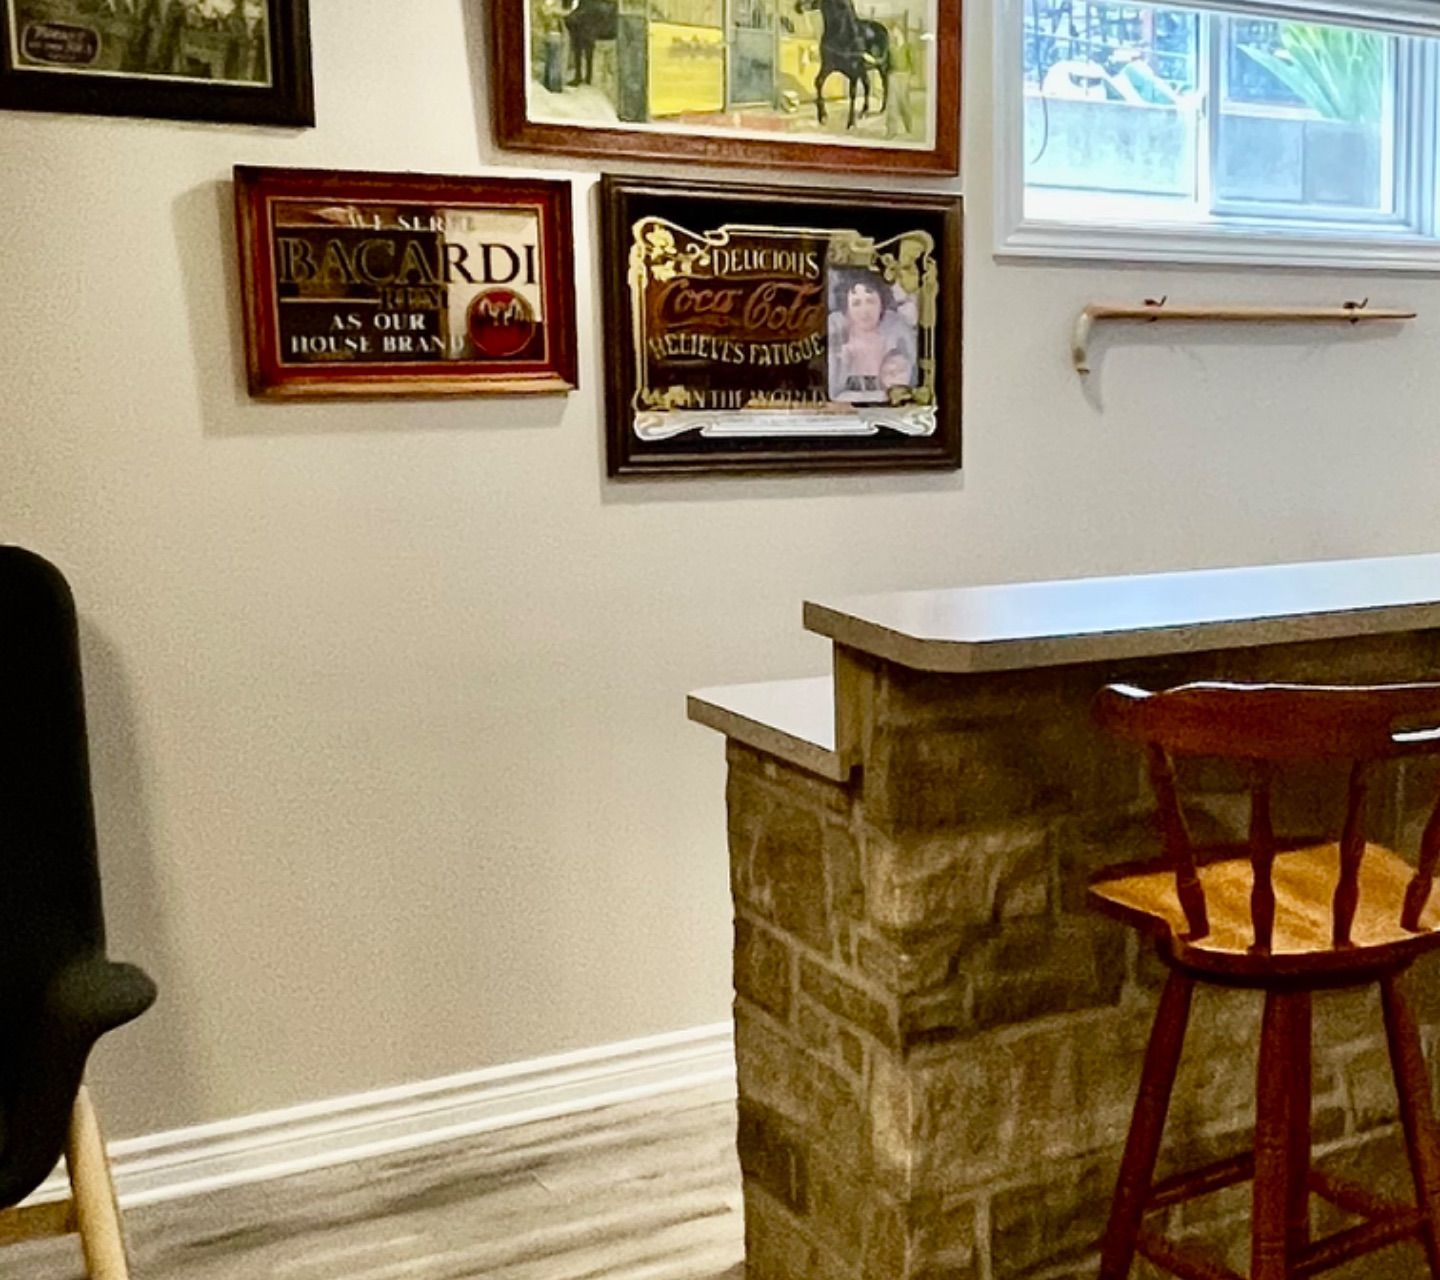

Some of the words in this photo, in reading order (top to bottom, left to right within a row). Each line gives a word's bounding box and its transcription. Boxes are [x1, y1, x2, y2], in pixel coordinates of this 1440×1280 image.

[279, 236, 537, 286] BACARDI
[712, 248, 820, 279] DELICIOUS
[332, 313, 363, 332] AS
[373, 312, 427, 331] OUR
[291, 335, 374, 354] HOUSE
[383, 334, 466, 354] BRAND
[649, 331, 745, 365] RELIEVES
[750, 331, 825, 366] FATIGUE
